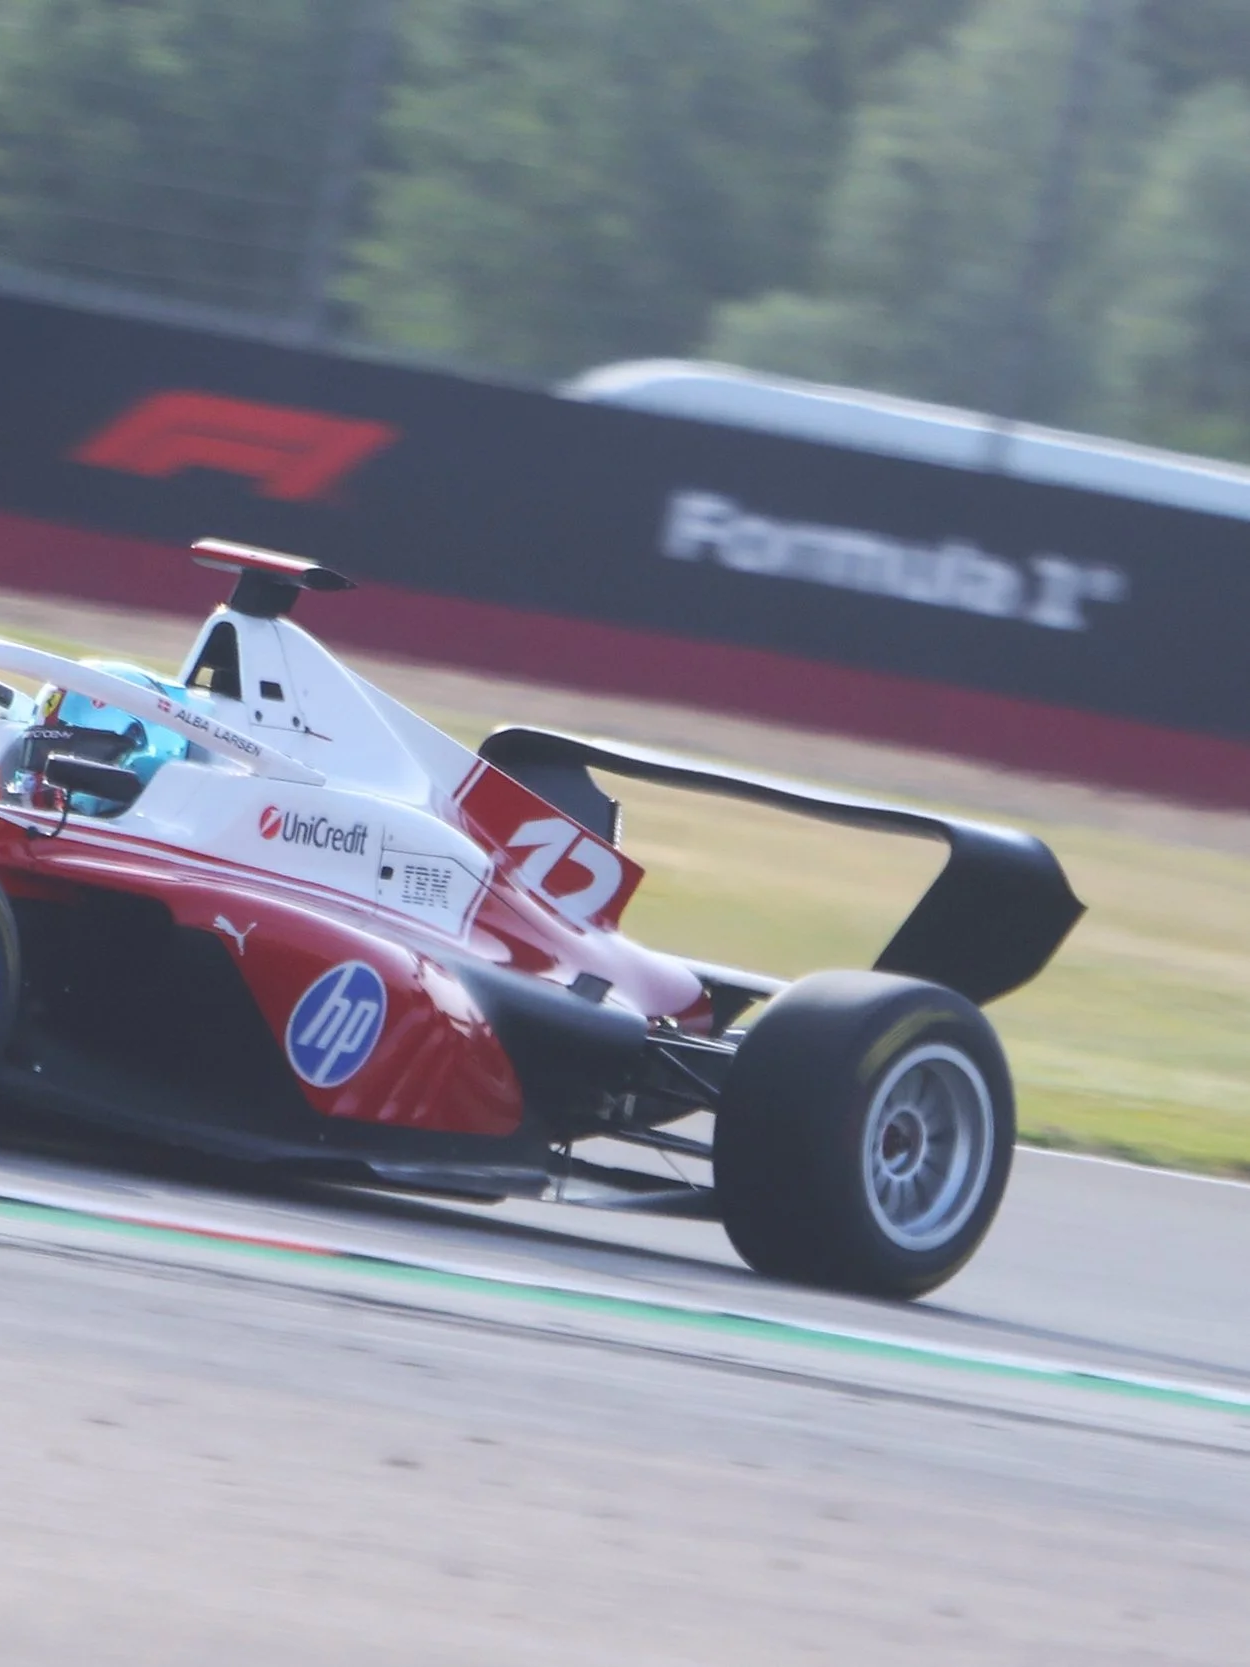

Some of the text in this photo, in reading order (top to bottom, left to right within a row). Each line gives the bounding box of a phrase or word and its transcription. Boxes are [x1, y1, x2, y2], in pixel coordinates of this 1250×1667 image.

[70, 389, 402, 500] F1
[662, 490, 1026, 618] Formula
[174, 709, 263, 757] ALBA LARSEN
[282, 810, 369, 856] UniCredit
[402, 864, 452, 910] IBM
[296, 963, 380, 1084] hp
